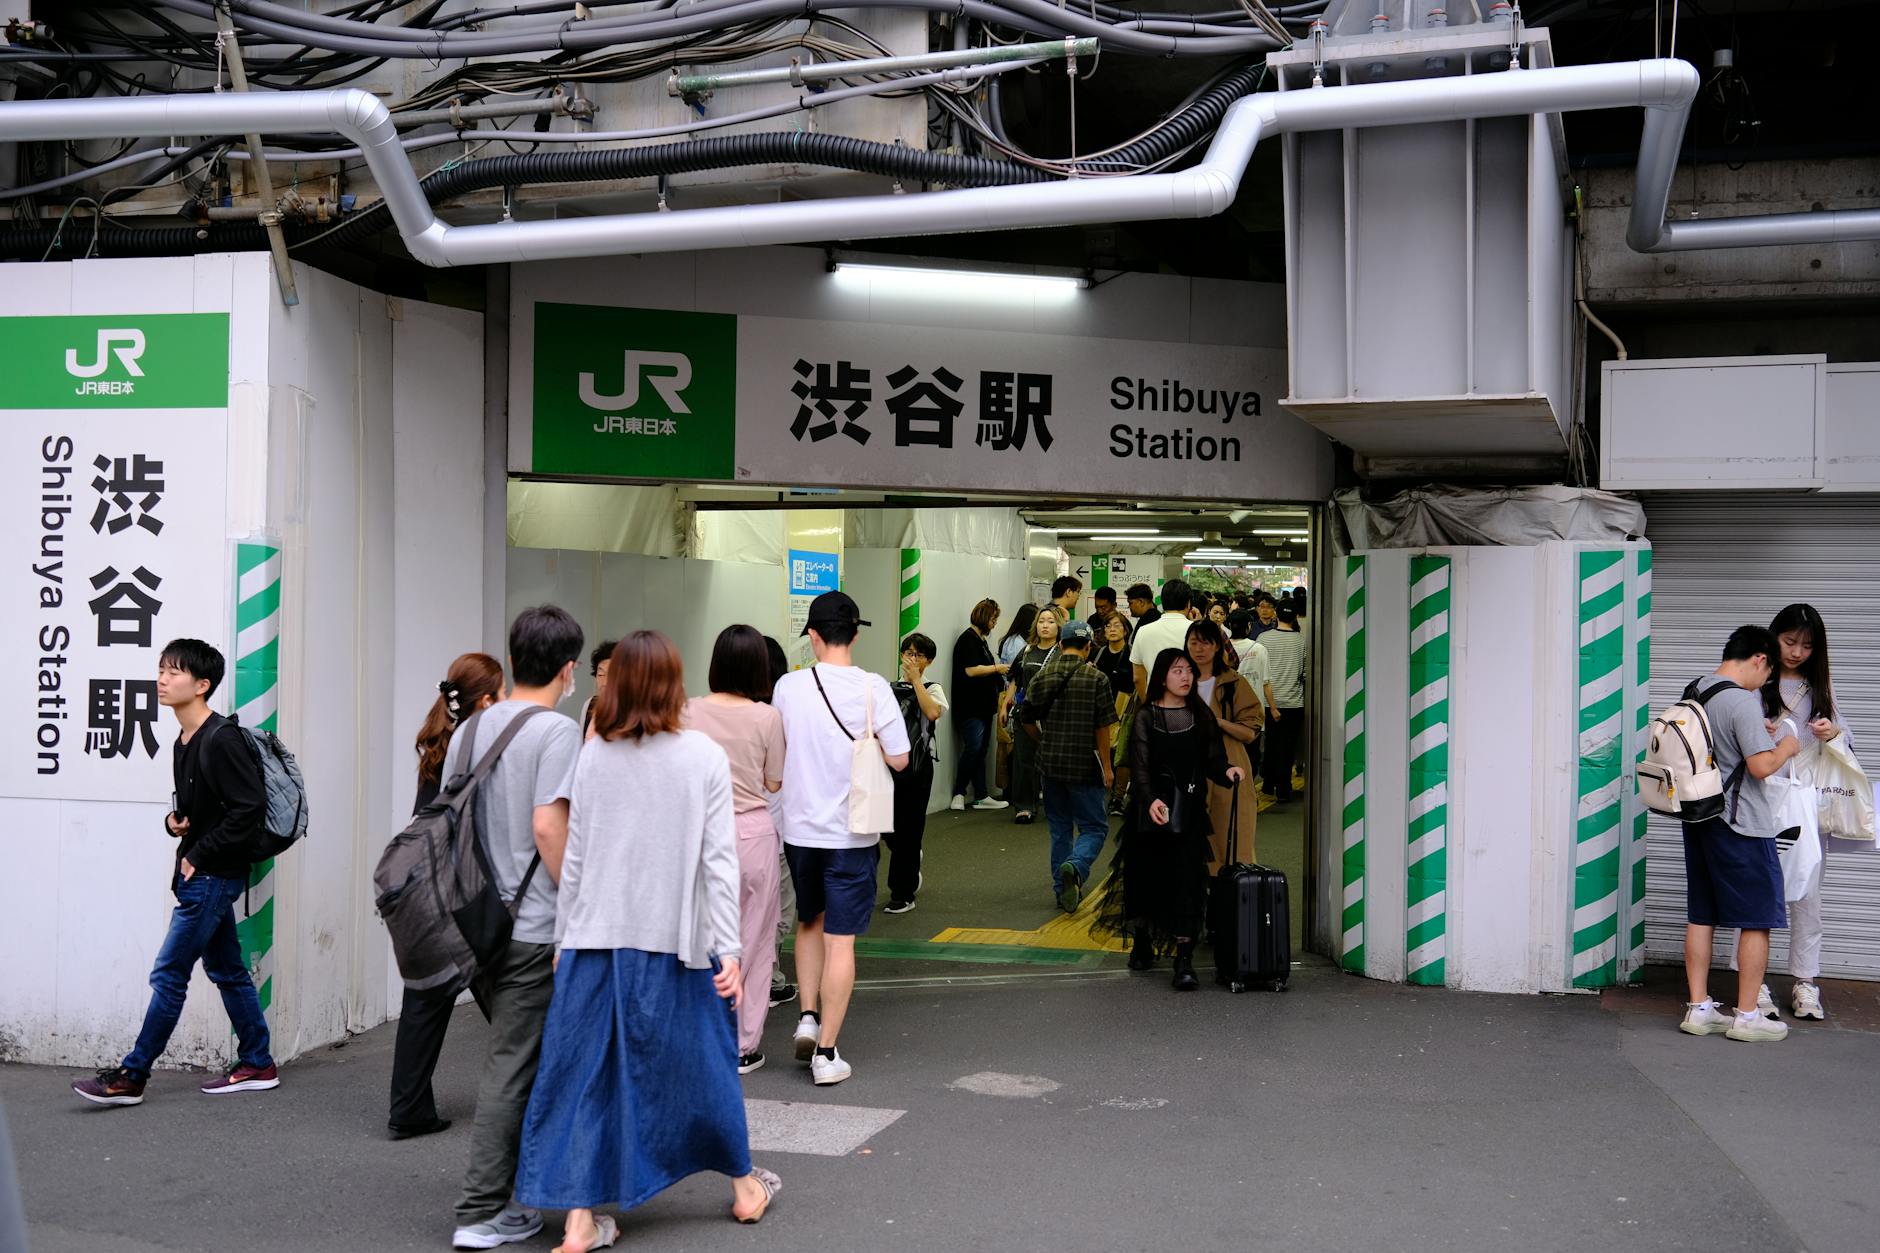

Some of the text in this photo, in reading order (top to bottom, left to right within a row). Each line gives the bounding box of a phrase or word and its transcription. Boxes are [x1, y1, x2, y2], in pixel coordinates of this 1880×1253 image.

[65, 328, 146, 377] JR
[76, 380, 134, 396] JR東日本
[579, 350, 691, 414] JR
[790, 359, 1053, 452] 渋谷駅
[1110, 376, 1261, 423] Shibuya
[594, 416, 677, 437] JR東日本
[1109, 424, 1240, 461] Station
[1093, 558, 1108, 567] JR
[33, 435, 74, 775] Shibuya Station
[84, 454, 165, 760] 渋谷駅
